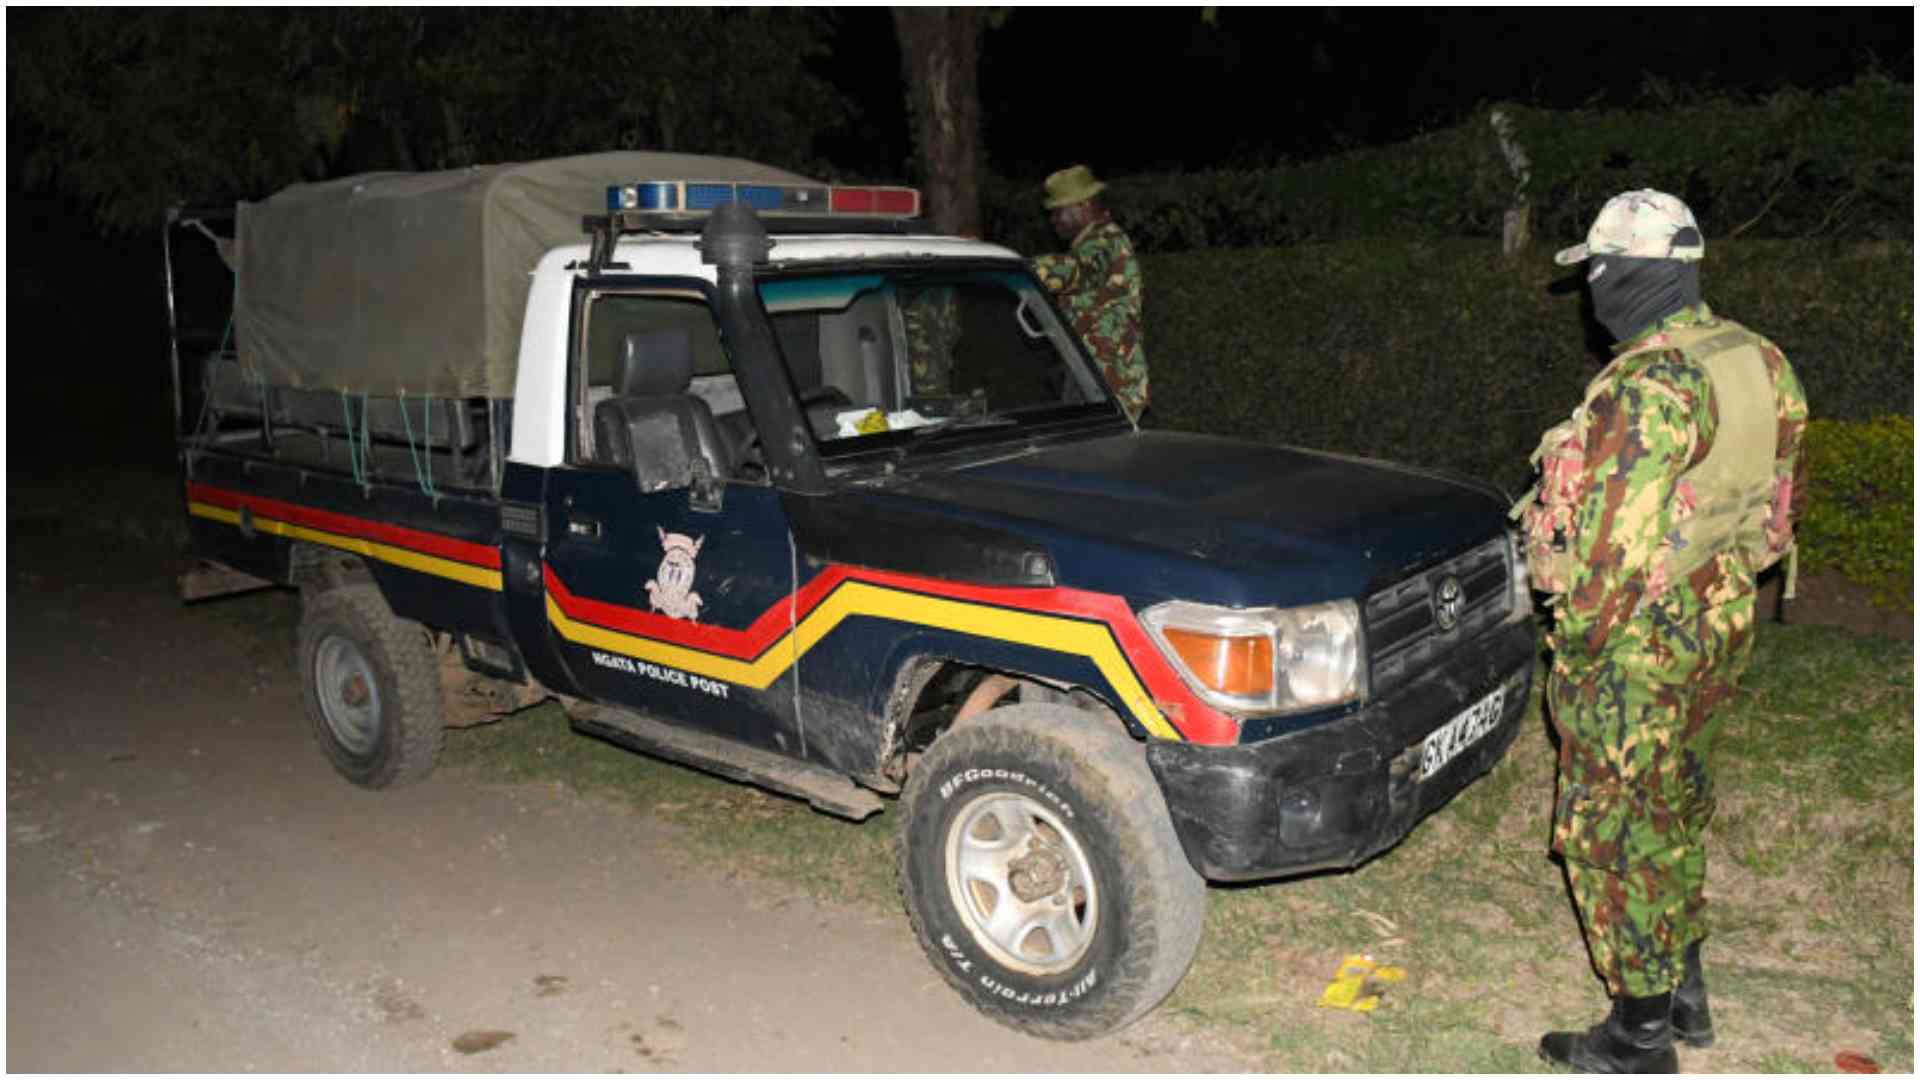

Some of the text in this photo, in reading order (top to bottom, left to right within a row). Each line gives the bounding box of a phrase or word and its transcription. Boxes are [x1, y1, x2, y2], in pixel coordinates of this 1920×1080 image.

[591, 650, 730, 699] NGATA POLICE POST
[940, 768, 1075, 818] BFGoodrich
